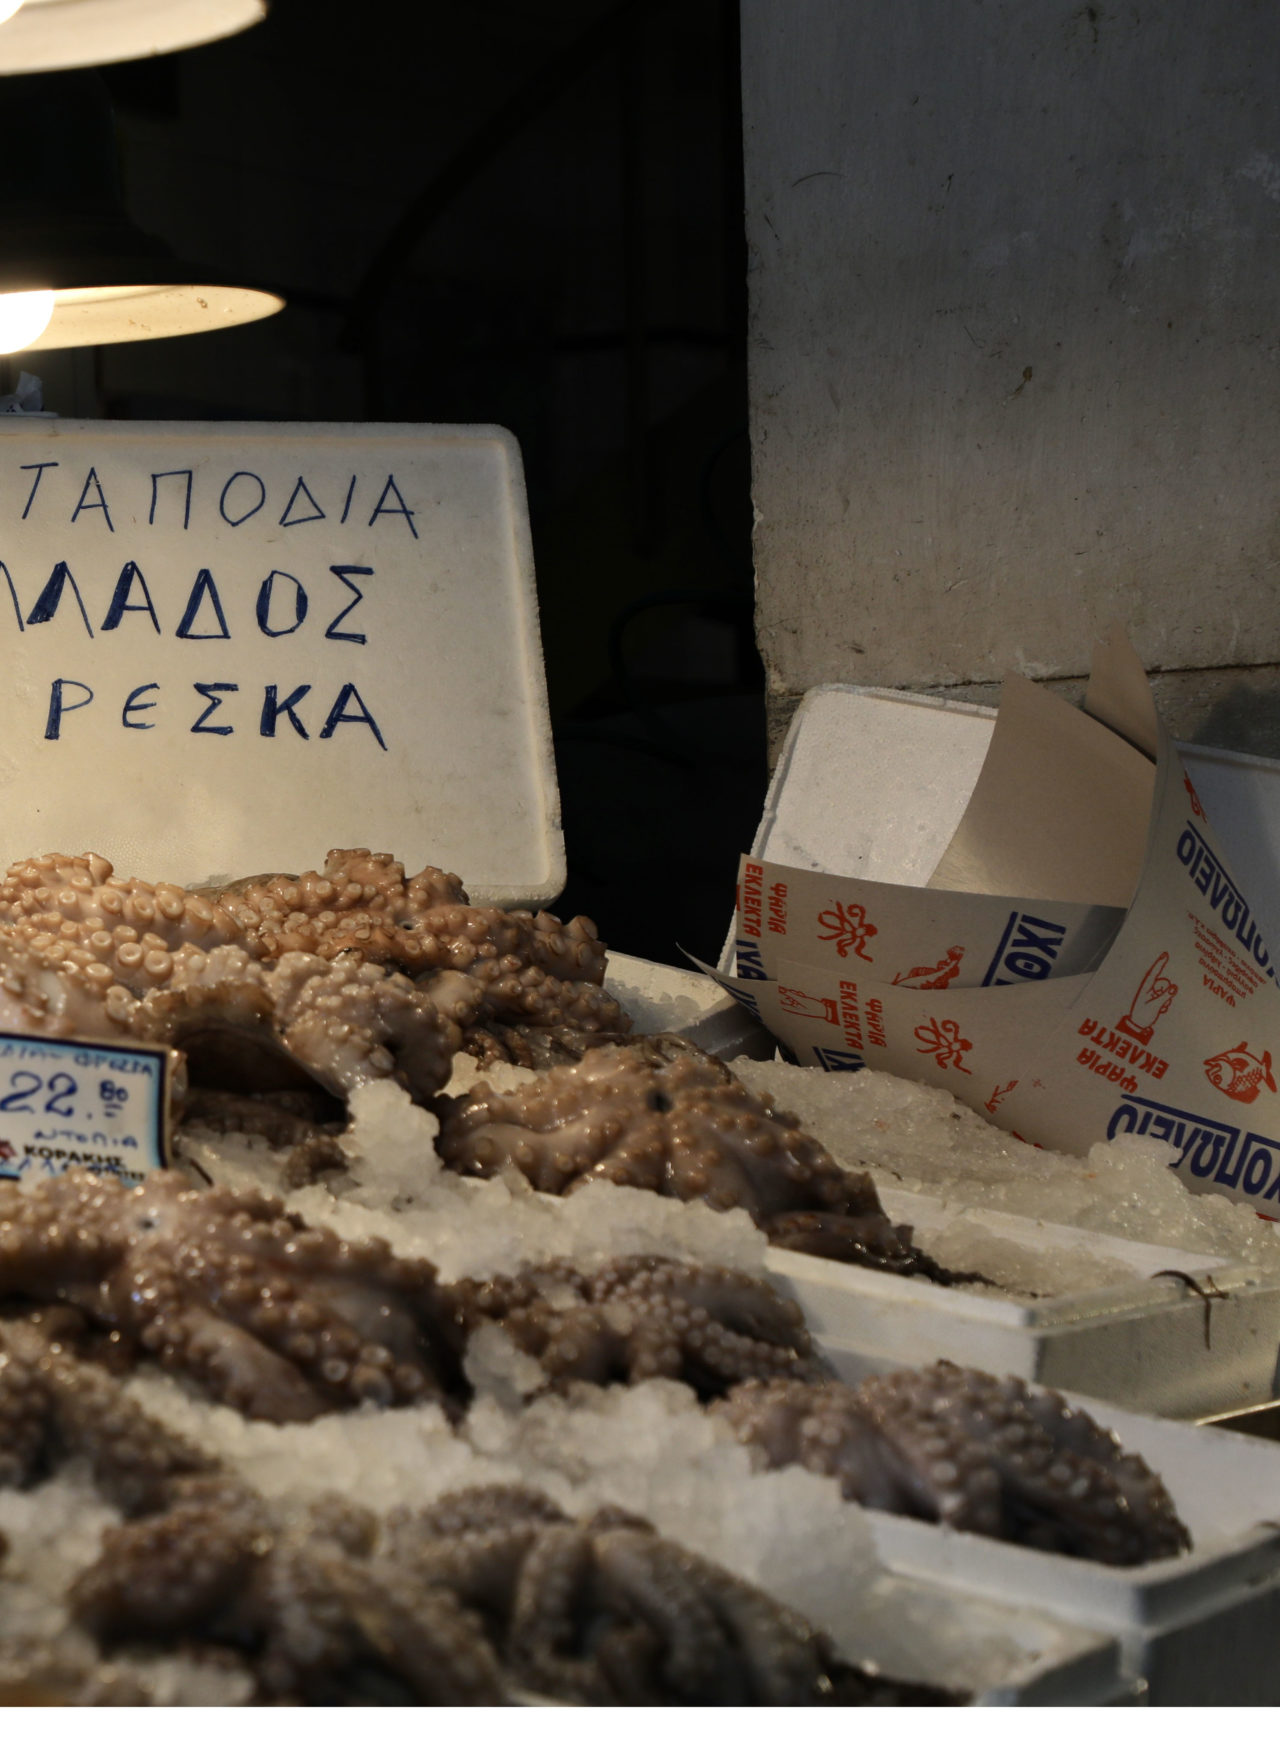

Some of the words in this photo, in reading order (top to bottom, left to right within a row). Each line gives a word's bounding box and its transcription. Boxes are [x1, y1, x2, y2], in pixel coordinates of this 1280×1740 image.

[743, 862, 764, 938] ΕΚΛΕΚΤΑ
[767, 882, 788, 936] ΨΑΡΙΑ
[996, 913, 1067, 985] ΙΧΘ
[839, 980, 865, 1050] ΕΚΛΕΚΤΑ
[1202, 973, 1236, 1008] ΨΑΡΙΑ
[865, 998, 888, 1048] ΨΑΡΙΑ
[1078, 1017, 1170, 1080] ΕΚΛΕΚΤΑ
[1076, 1047, 1139, 1094] ΨΑΡΙΑ
